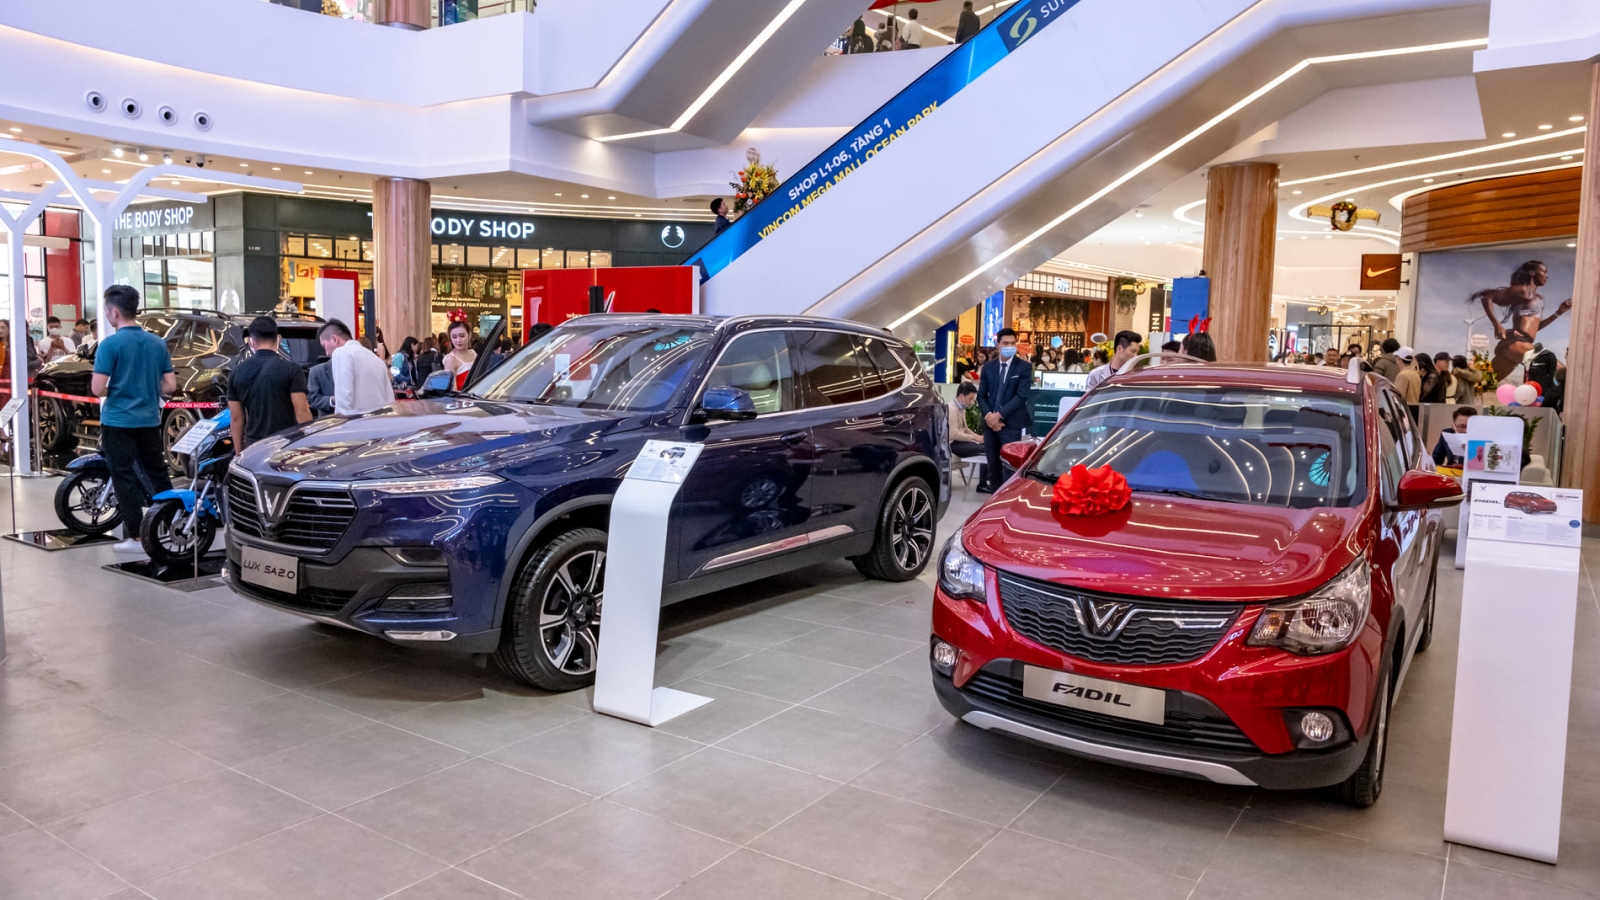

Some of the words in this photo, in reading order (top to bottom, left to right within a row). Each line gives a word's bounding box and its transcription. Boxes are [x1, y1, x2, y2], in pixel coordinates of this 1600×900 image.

[1040, 0, 1065, 18] SU
[757, 204, 801, 240] VINCOM
[801, 180, 834, 209] MEGA
[833, 158, 863, 184] MALL
[865, 125, 906, 161] OCEAN
[906, 100, 939, 132] PARK
[788, 172, 819, 201] SHOP
[818, 150, 852, 178] L1-06,
[850, 124, 883, 153] TẦNG
[883, 117, 892, 128] 1
[135, 209, 163, 229] BODY
[164, 206, 194, 226] SHOP
[430, 217, 475, 236] ODY
[479, 220, 535, 239] SHOP
[1151, 313, 1161, 333] INI
[243, 559, 261, 572] LUX
[1052, 682, 1132, 707] FADIL
